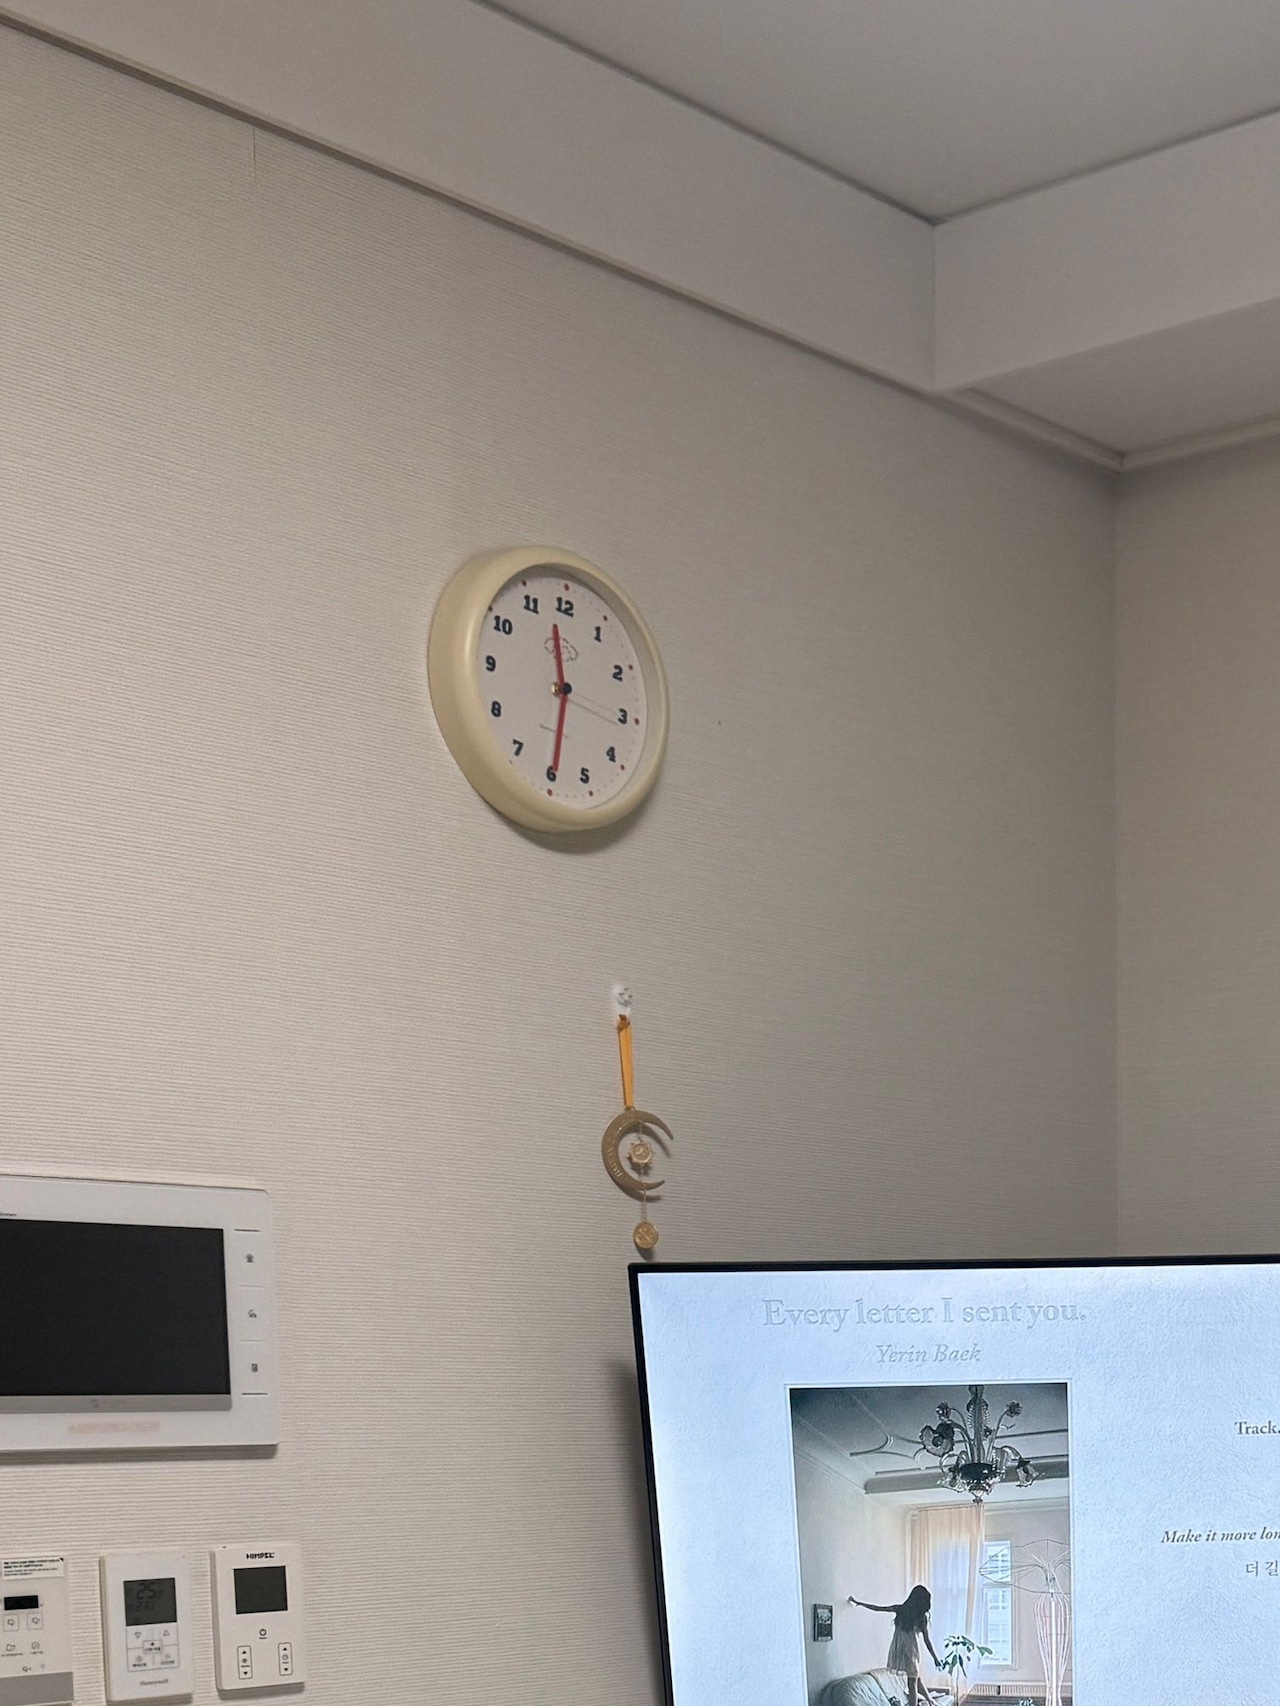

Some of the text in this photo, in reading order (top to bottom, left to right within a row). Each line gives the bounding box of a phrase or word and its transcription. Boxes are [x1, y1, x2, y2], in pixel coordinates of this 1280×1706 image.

[524, 595, 539, 614] 11
[556, 597, 574, 618] 12
[494, 615, 513, 635] 10
[594, 626, 602, 642] 1
[485, 655, 496, 672] 9
[612, 664, 623, 682] 2
[491, 700, 502, 718] 8
[617, 708, 628, 725] 3
[512, 739, 524, 756] 7
[606, 746, 616, 763] 4
[546, 765, 557, 782] 6
[580, 767, 590, 784] 5
[762, 1297, 1087, 1333] Every letter I sent you.
[876, 1342, 981, 1365] Yerin Baek
[1235, 1420, 1280, 1435] Track.
[1160, 1530, 1202, 1544] Make
[1205, 1529, 1217, 1542] it
[1220, 1530, 1257, 1542] more
[1245, 1561, 1259, 1576] 더
